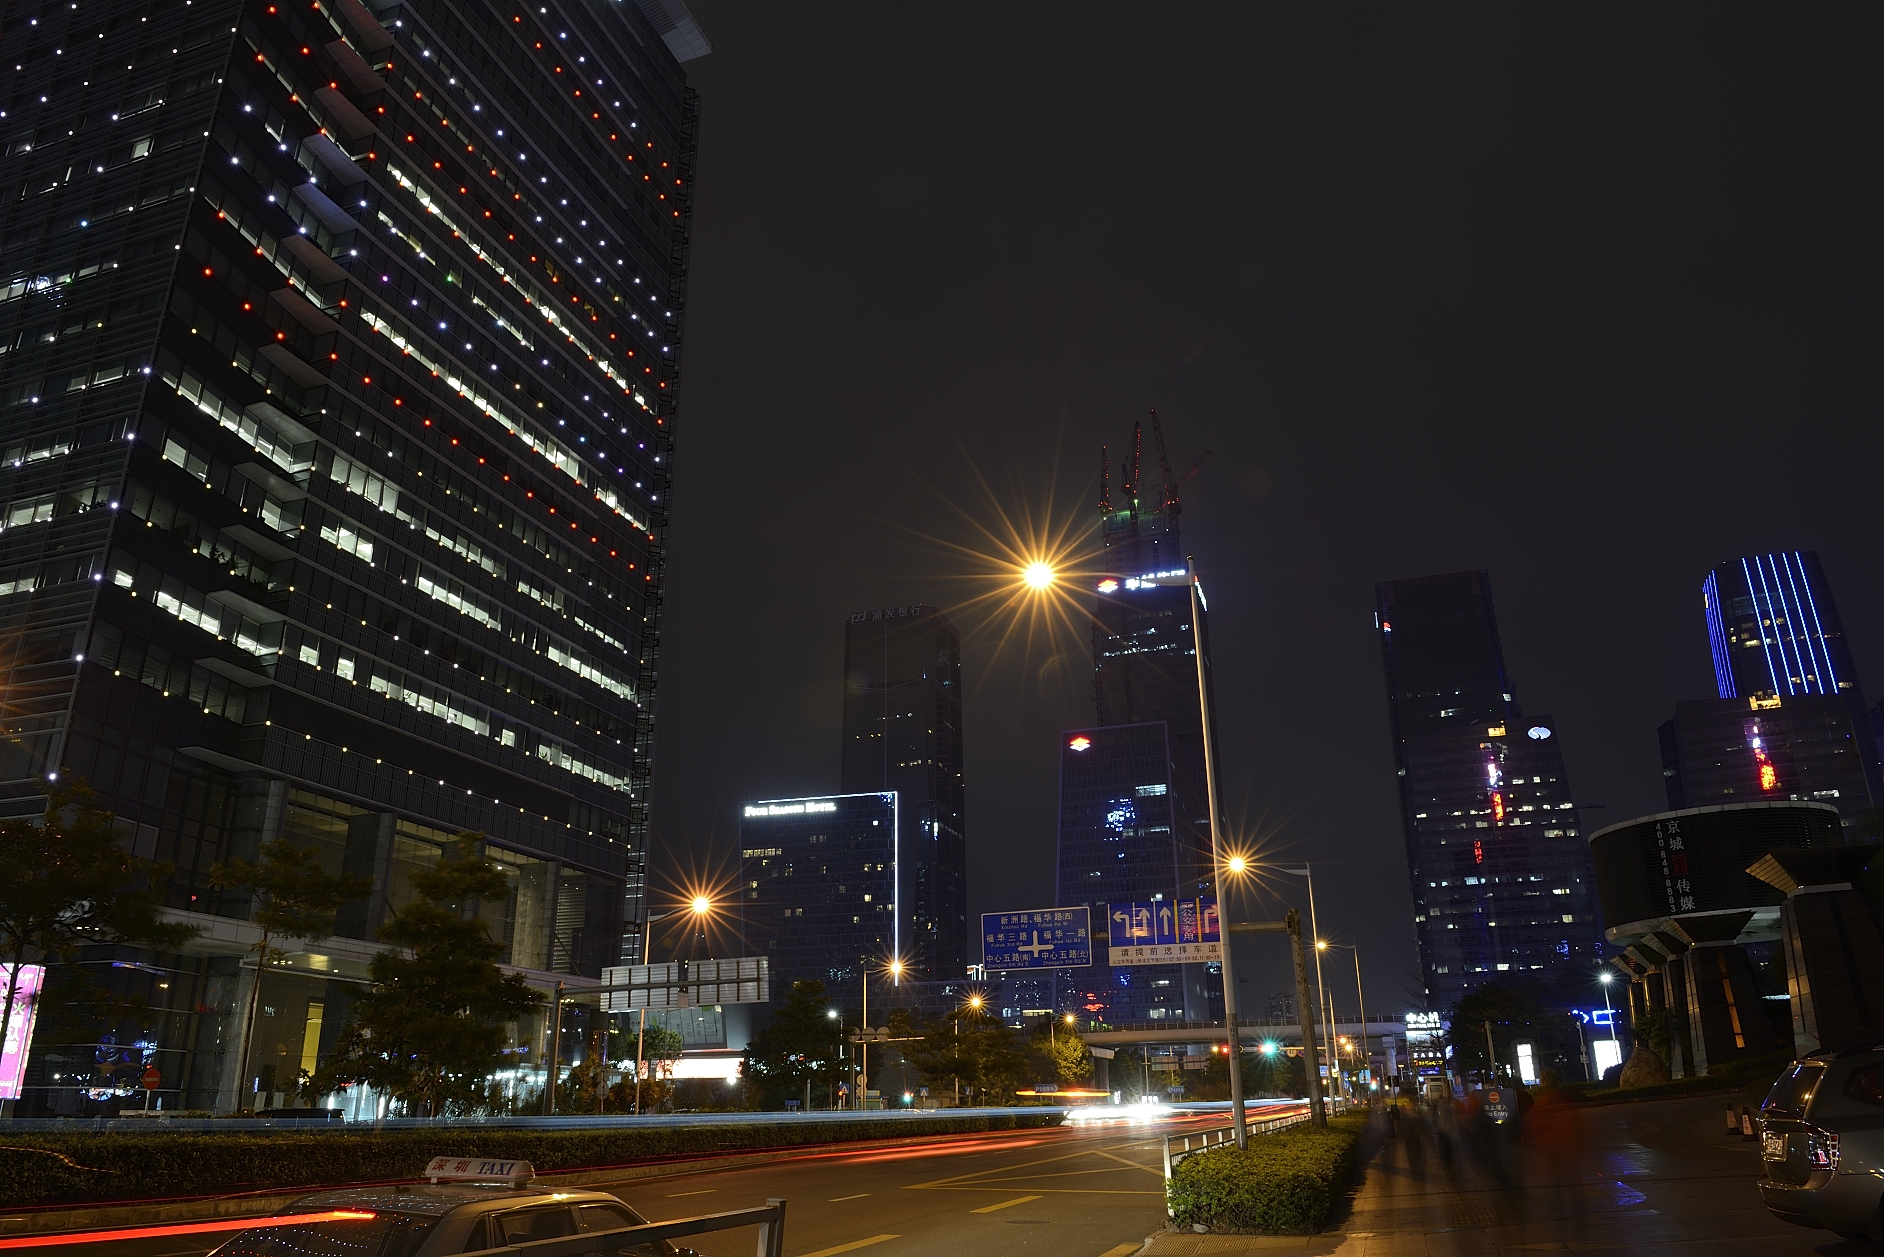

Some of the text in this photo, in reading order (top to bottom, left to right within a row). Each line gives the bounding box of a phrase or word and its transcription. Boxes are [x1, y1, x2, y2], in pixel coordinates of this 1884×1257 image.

[872, 604, 922, 621] 浦发银行
[1182, 909, 1194, 941] 公交专用
[986, 932, 1027, 942] 福华三路
[1044, 928, 1086, 939] 福华一路
[1042, 950, 1088, 960] 中心五路(北)
[1120, 944, 1217, 957] 请提前选择车道
[986, 953, 1031, 963] 中心五路(南)
[432, 1159, 472, 1173] 深圳
[477, 1162, 517, 1175] TAXI
